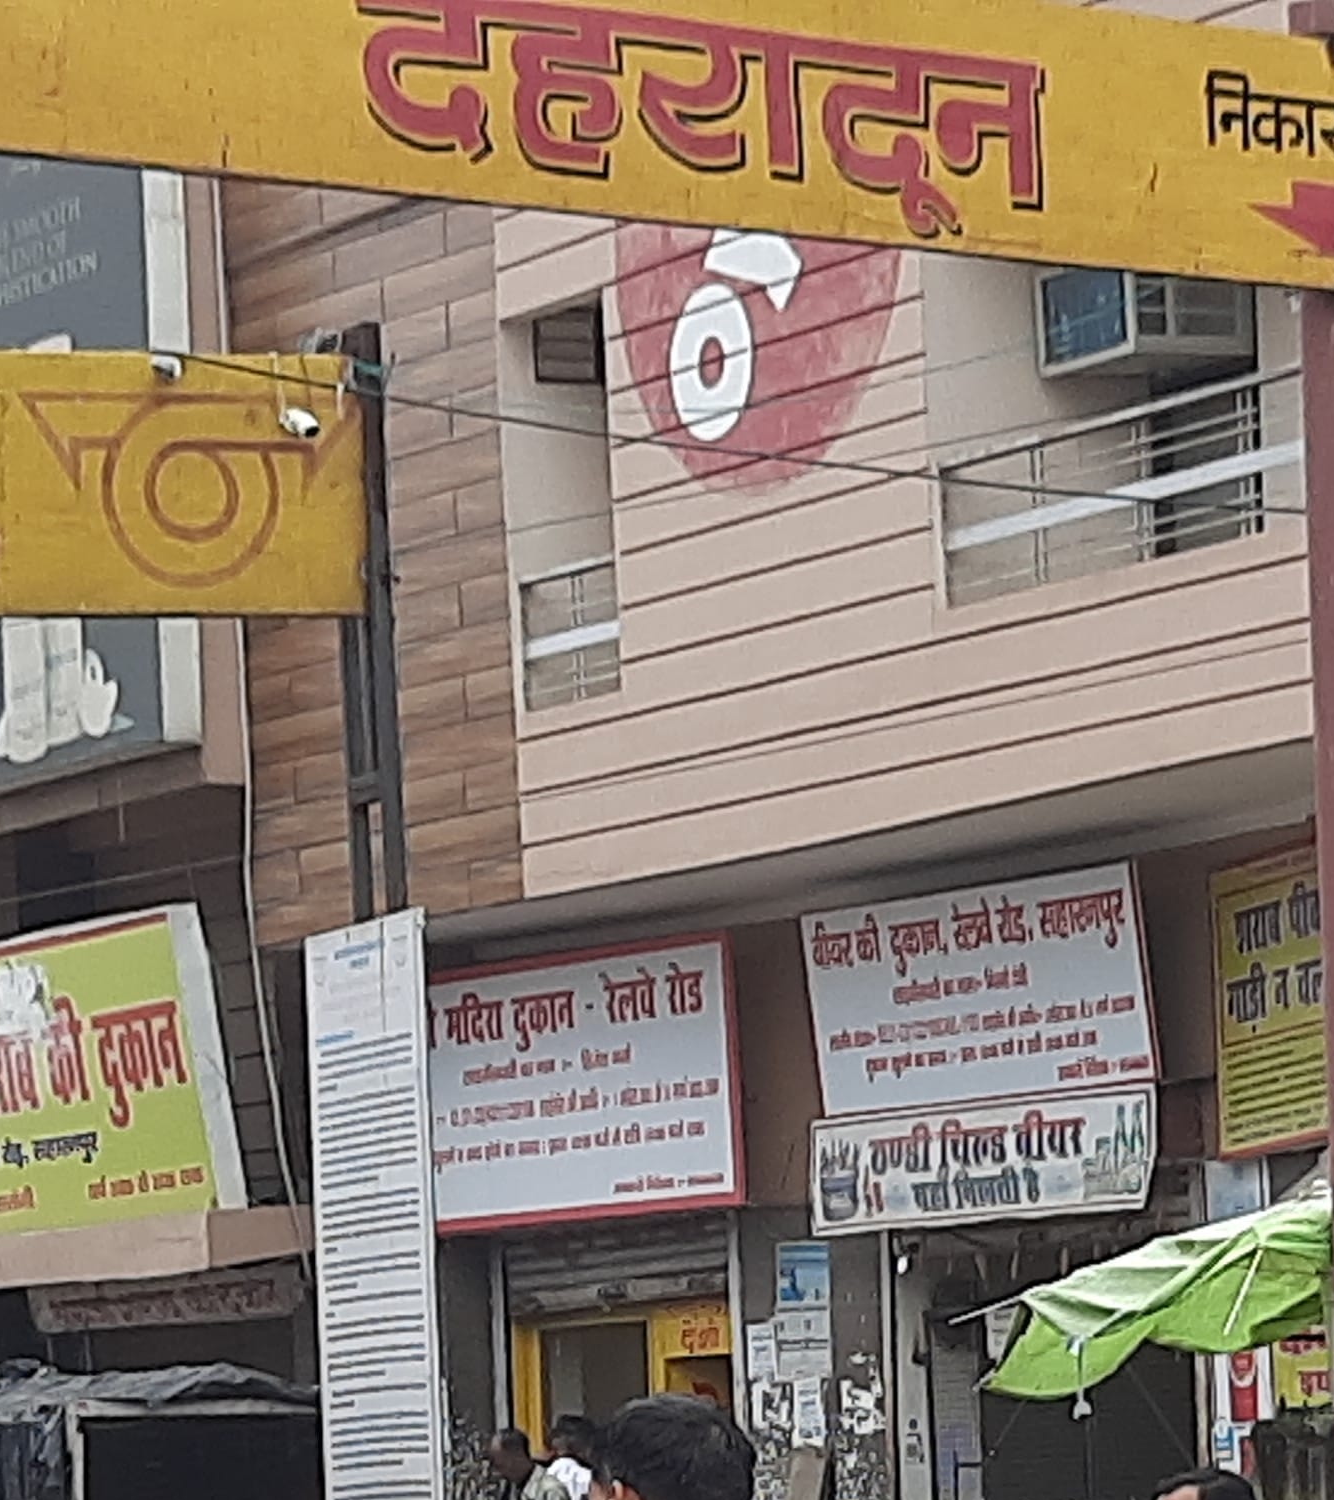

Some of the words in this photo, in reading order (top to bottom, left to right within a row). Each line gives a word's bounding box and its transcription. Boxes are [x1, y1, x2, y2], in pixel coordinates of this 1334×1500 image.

[356, 0, 1046, 236] दहरादून
[90, 999, 189, 1128] दुकान
[444, 991, 505, 1046] मदिरा
[510, 989, 575, 1053] दुकान
[598, 965, 658, 1024] रेलवे
[665, 960, 704, 1017] रोड
